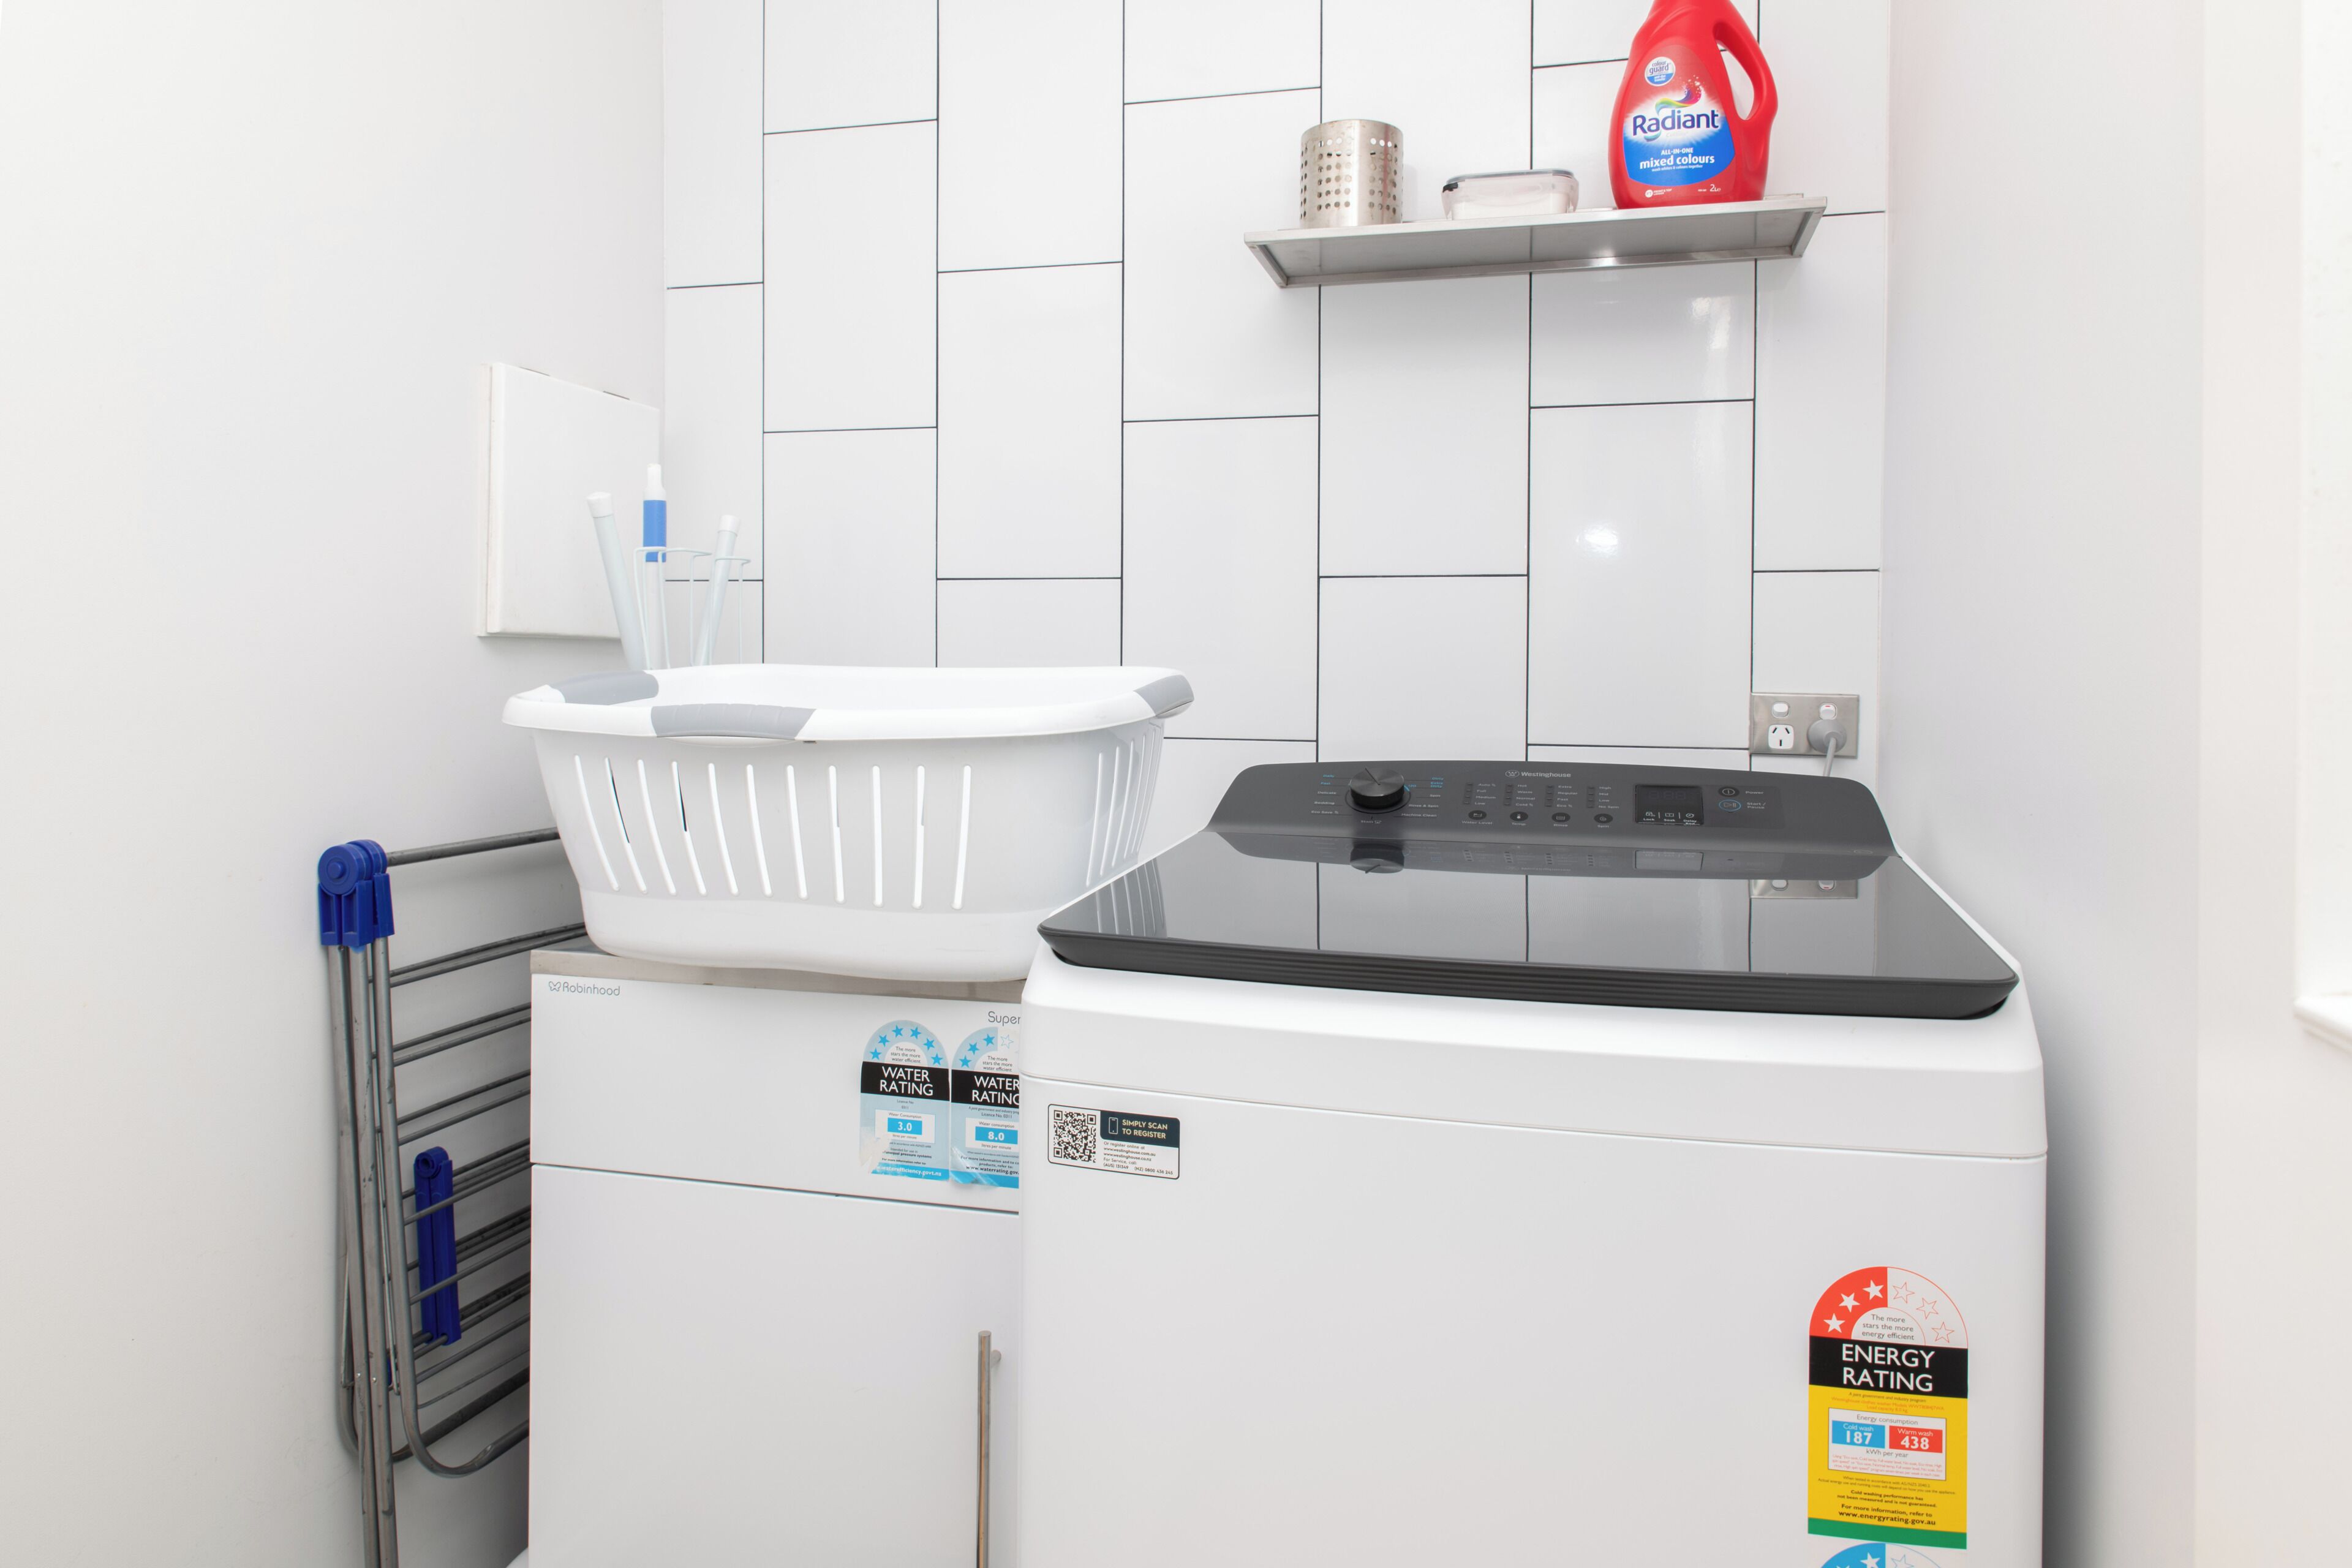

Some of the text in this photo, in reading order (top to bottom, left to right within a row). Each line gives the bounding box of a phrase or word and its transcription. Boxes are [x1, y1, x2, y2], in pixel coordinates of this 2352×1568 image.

[1649, 64, 1668, 75] guard
[1633, 110, 1719, 136] Radiant
[1640, 154, 1715, 169] mixed colours
[563, 982, 620, 996] Robinhood
[988, 1011, 1021, 1027] Super
[882, 1066, 930, 1082] WATER
[880, 1080, 933, 1096] RATING
[974, 1076, 1019, 1091] WATER
[898, 1122, 912, 1131] 3.0
[1122, 1119, 1146, 1128] SIMPLY
[988, 1131, 1005, 1141] 8.0
[1133, 1129, 1166, 1139] REGISTER
[1104, 1147, 1156, 1156] www.westinghouse.com.au
[1104, 1153, 1152, 1161] www.westinghouse.co.nz
[1842, 1343, 1936, 1368] ENERGY
[1843, 1367, 1933, 1392] RATING
[1857, 1414, 1918, 1426] Energy consumption
[1845, 1430, 1872, 1445] 187
[1901, 1436, 1929, 1450] 438
[1839, 1511, 1936, 1526] www.energyrating.gov.au
[1871, 1507, 1908, 1516] information,
